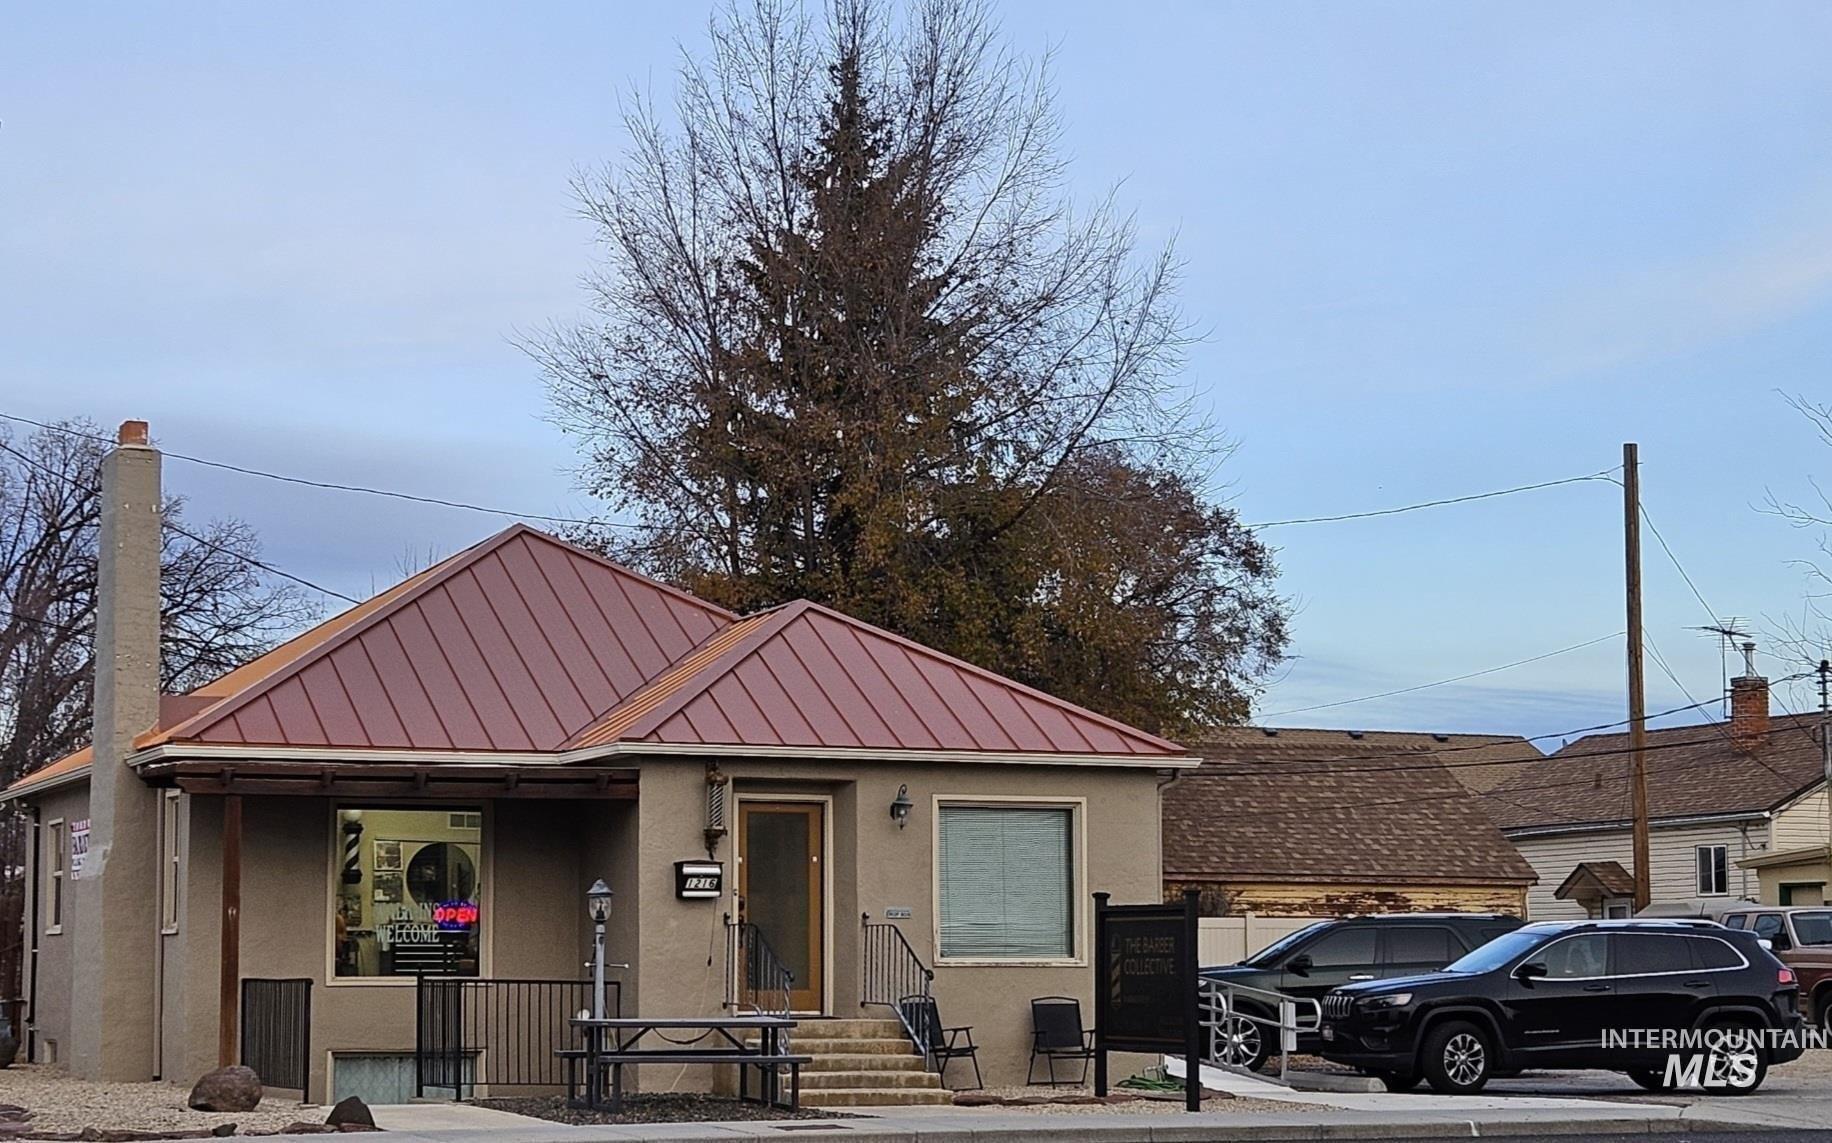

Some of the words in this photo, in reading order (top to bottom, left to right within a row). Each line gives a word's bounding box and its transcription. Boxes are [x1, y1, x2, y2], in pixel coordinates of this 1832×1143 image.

[687, 878, 717, 889] 1216
[433, 907, 477, 922] OPEN
[376, 924, 440, 943] WELCOME
[1125, 938, 1141, 953] THE
[1143, 937, 1175, 953] BARBER
[1124, 958, 1176, 975] COLLECTIVE
